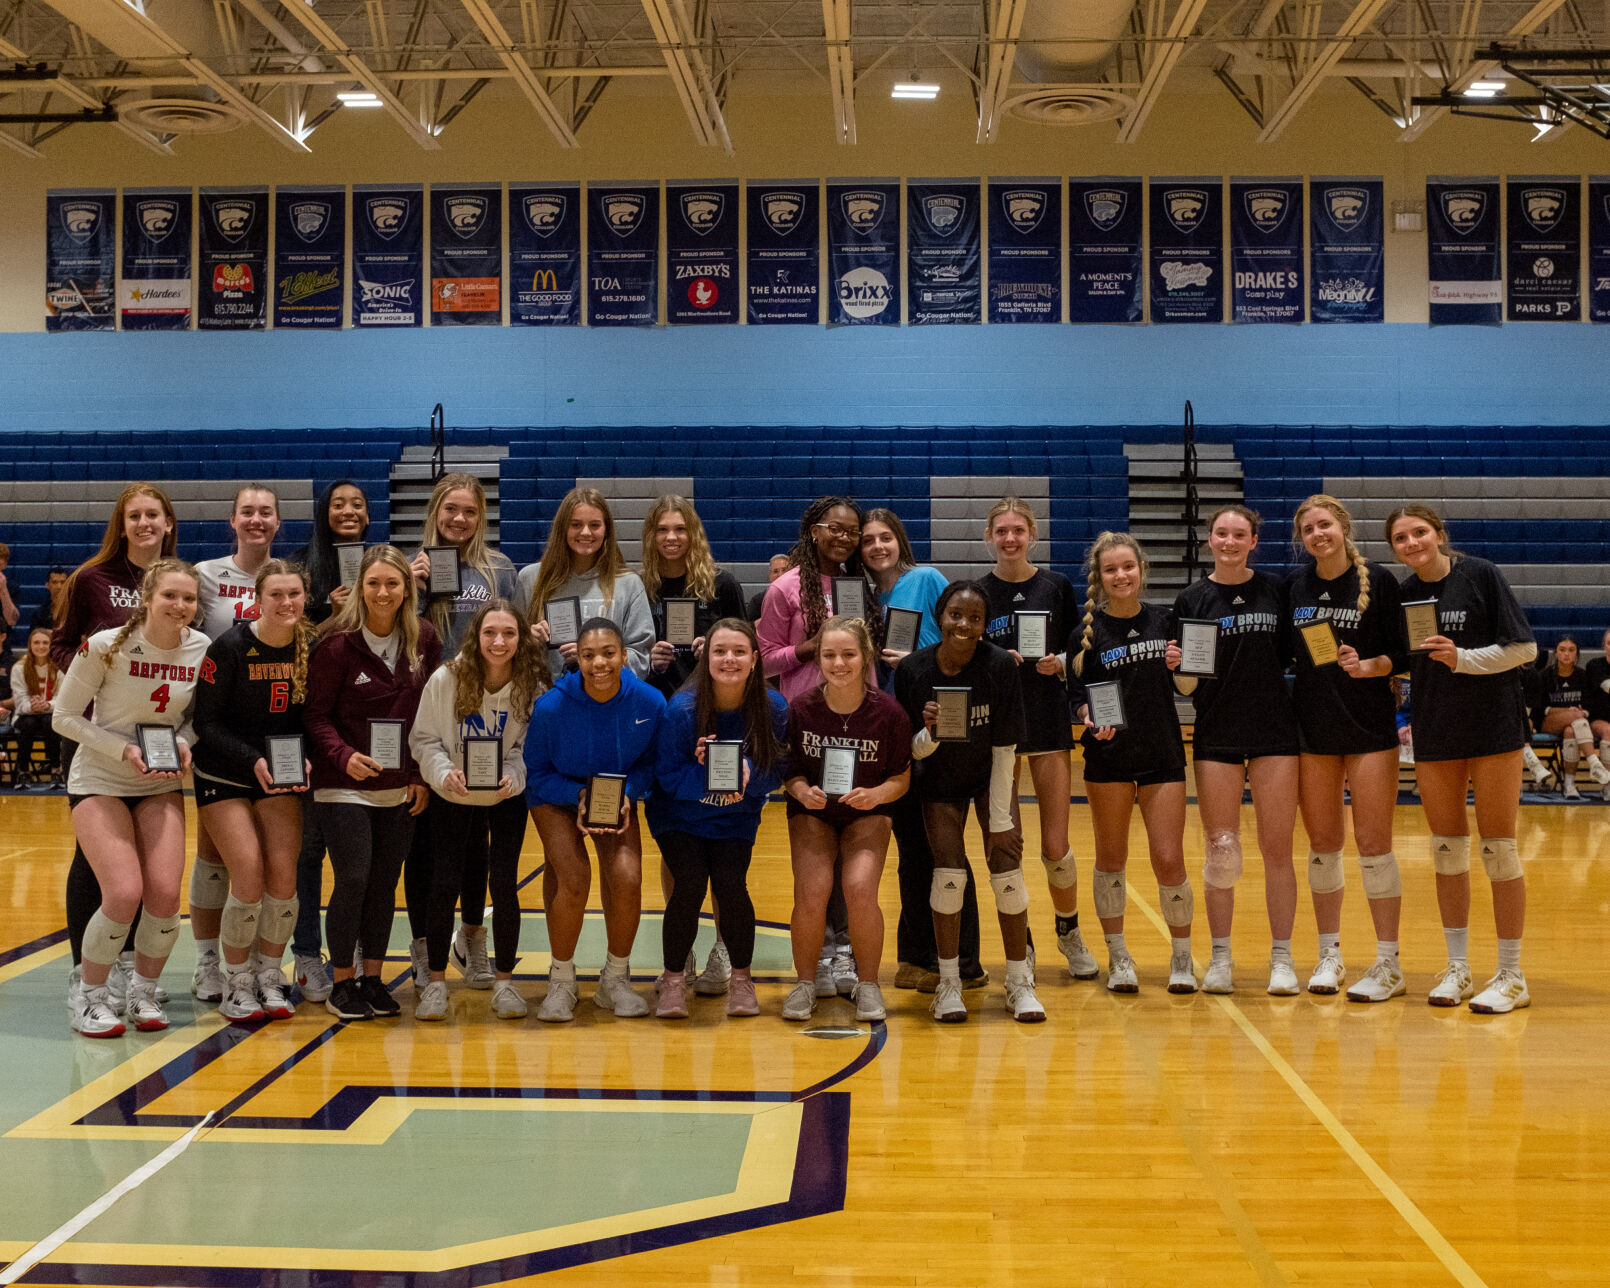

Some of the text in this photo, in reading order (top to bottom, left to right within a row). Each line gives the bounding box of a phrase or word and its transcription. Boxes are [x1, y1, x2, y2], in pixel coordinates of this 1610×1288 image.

[928, 198, 960, 208] CENTENNIAL
[1089, 192, 1122, 202] CENTENNIAL
[676, 263, 730, 280] ZAXBY'S
[1080, 272, 1132, 281] A MOMENT'S
[1236, 271, 1298, 288] DRAKE'S
[364, 286, 410, 298] SONIC
[592, 277, 622, 291] TOA
[750, 286, 816, 294] THE KATINAS
[839, 280, 892, 300] Brixx
[1266, 290, 1285, 299] play
[214, 304, 254, 314] 615.790.2244
[1516, 304, 1551, 312] PARKS
[453, 584, 492, 602] klin
[234, 602, 262, 620] 14
[1238, 612, 1278, 626] BRUINS
[1292, 606, 1362, 622] LADY BRUINS
[1101, 646, 1128, 664] LADY
[129, 660, 196, 682] RAPTORS
[198, 656, 217, 684] R
[150, 684, 170, 713] 4
[270, 682, 288, 712] 6
[802, 730, 880, 751] FRANKLIN
